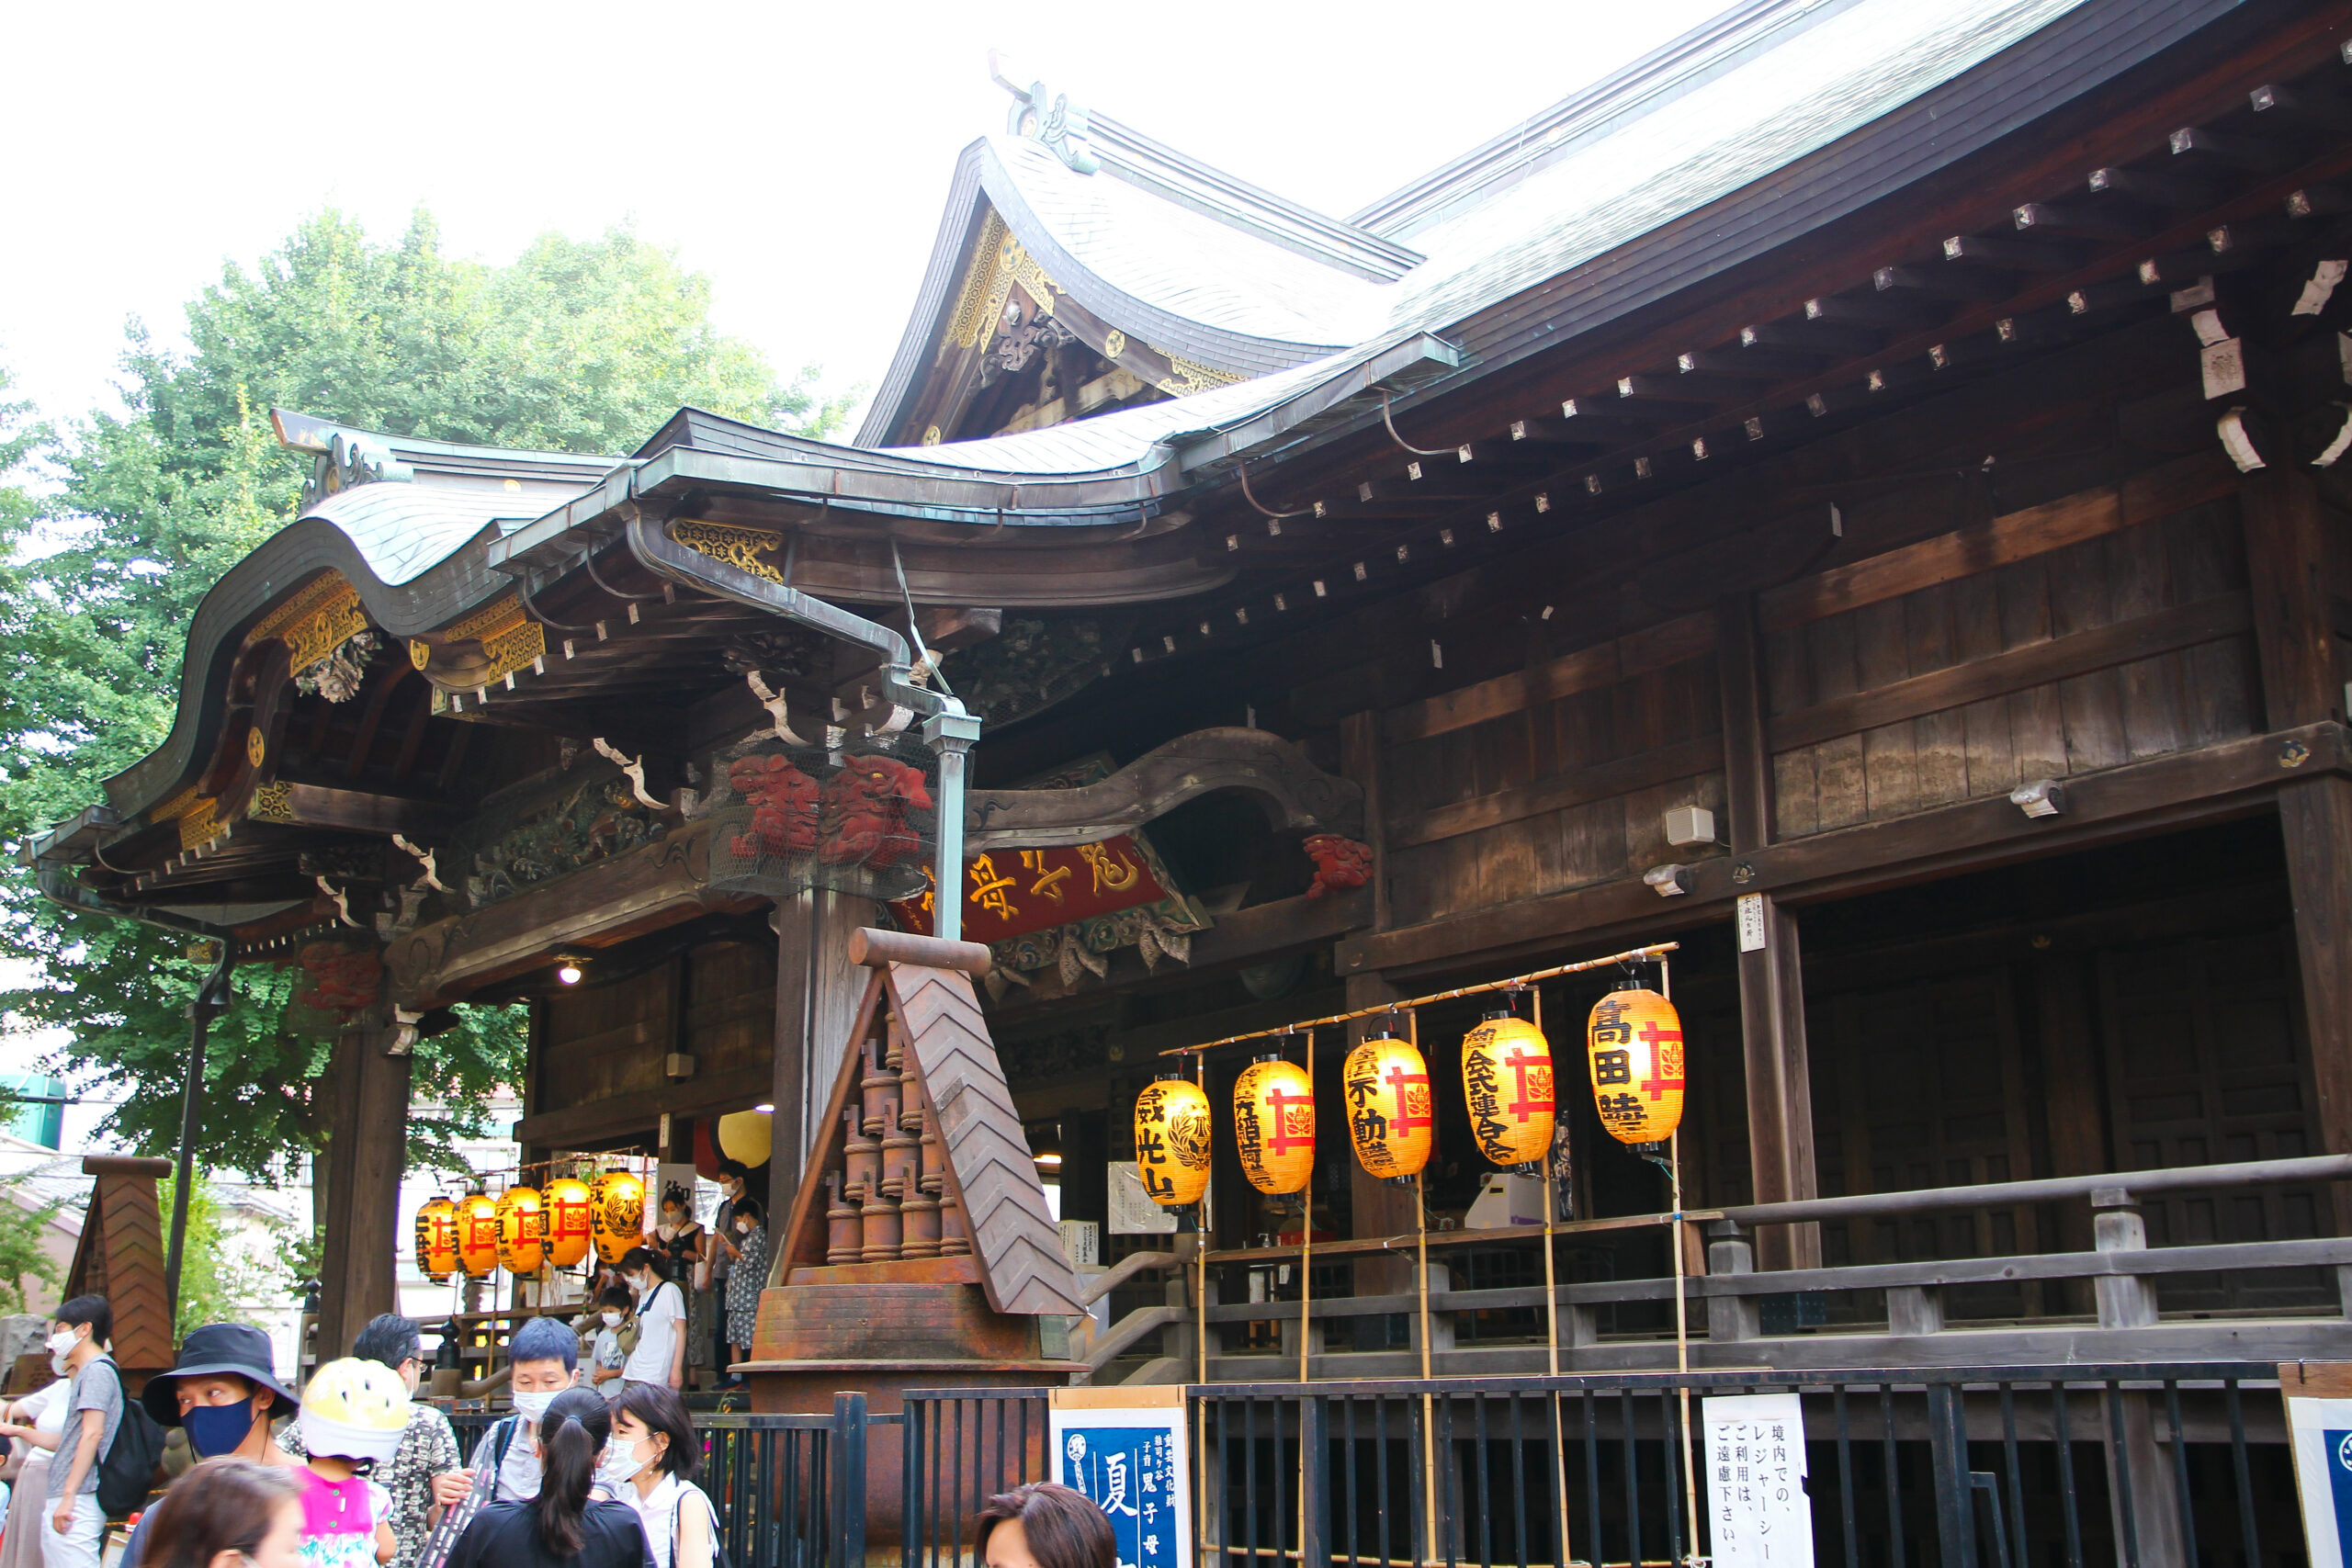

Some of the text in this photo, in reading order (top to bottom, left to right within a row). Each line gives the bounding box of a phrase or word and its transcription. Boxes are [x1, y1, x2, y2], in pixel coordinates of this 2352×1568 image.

[922, 842, 1138, 930] 鬼子母
[1466, 1028, 1515, 1160] 御会式連合会
[1591, 1000, 1648, 1135] 高田睦
[1138, 1088, 1175, 1200] 威光山
[1716, 1425, 1736, 1552] ご遠慮下さい。
[1735, 1425, 1752, 1511] ご利用は、
[1771, 1425, 1791, 1512] 境内での、
